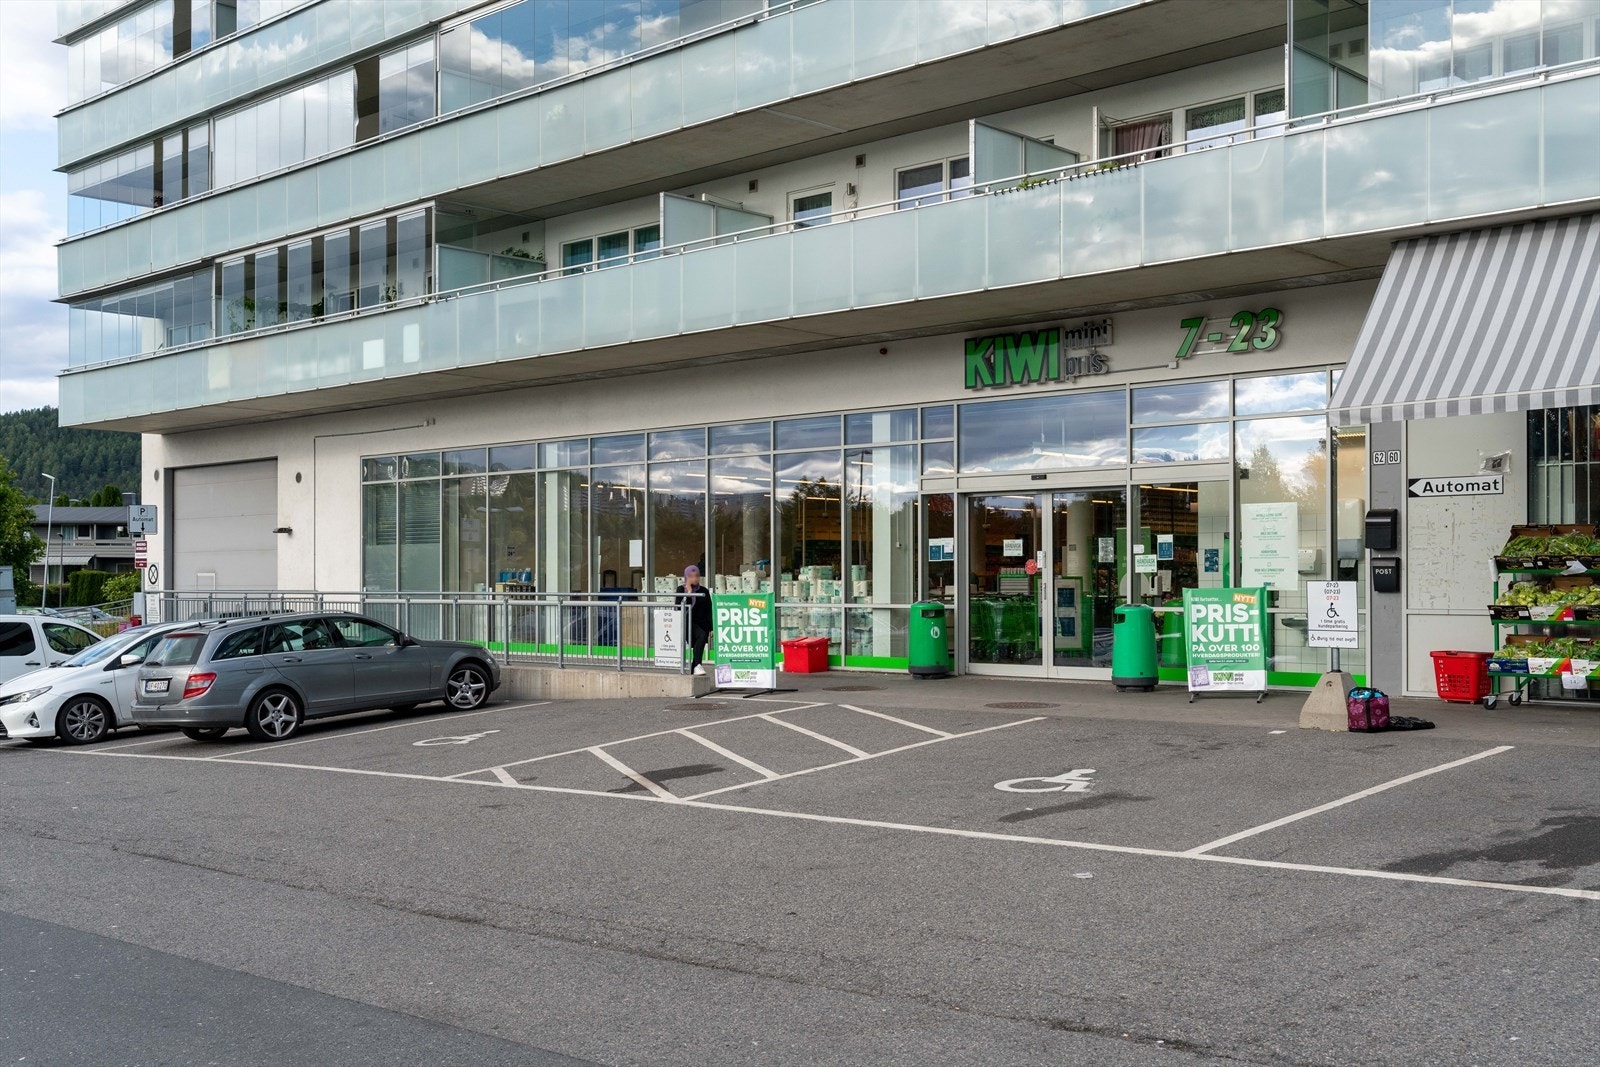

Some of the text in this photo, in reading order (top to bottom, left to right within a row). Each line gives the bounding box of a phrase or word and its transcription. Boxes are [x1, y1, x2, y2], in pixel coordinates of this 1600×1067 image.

[1065, 318, 1111, 349] mini
[964, 327, 1062, 389] KIWI
[1065, 346, 1108, 382] pris
[1374, 452, 1385, 463] 62
[1388, 451, 1399, 462] 60
[1422, 479, 1500, 493] Automat
[749, 599, 766, 608] NYTT
[1234, 593, 1256, 603] NYTT
[717, 607, 768, 626] PRIS-
[1191, 603, 1260, 623] PRIS-
[717, 626, 769, 643] KUTT!
[1192, 623, 1260, 643] KUTT!
[718, 643, 729, 652] PÅ
[1192, 643, 1260, 652] PÅ OVER 100
